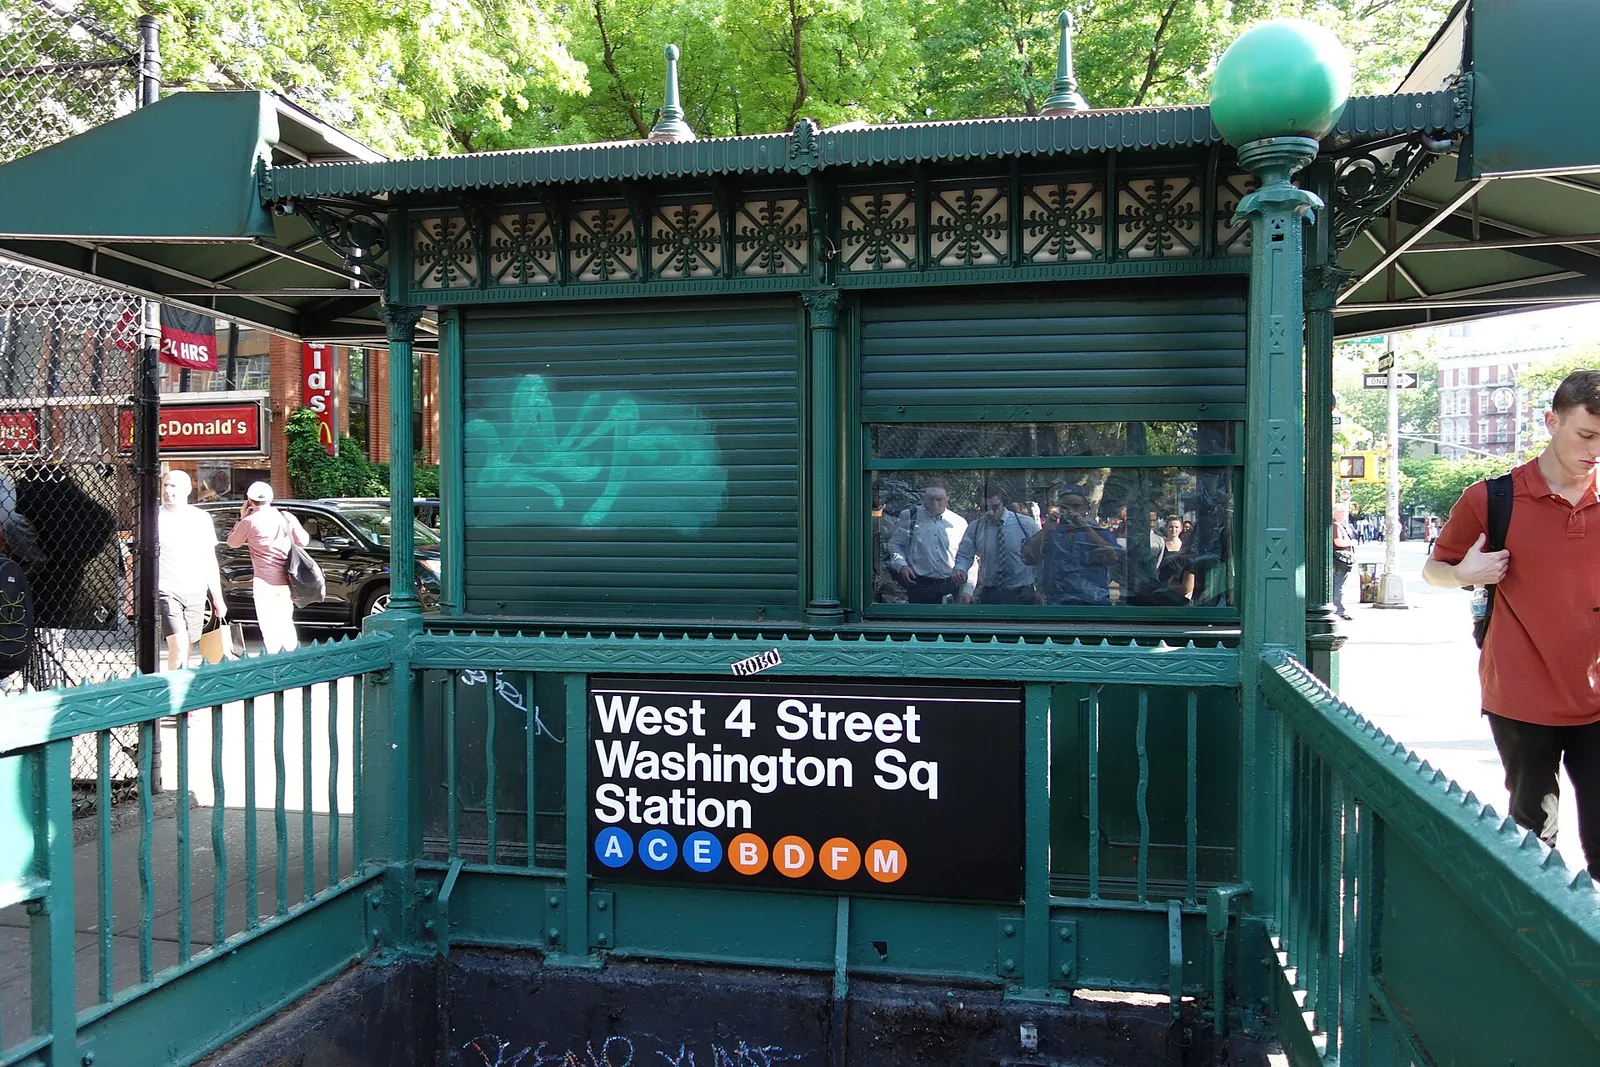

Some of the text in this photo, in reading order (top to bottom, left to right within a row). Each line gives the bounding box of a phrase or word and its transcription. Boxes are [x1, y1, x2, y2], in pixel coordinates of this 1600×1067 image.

[161, 338, 209, 362] 24 HRS
[1370, 378, 1387, 386] ONE
[159, 419, 247, 436] cDonald's
[733, 650, 779, 676] BOBO
[594, 694, 706, 737] West
[724, 698, 756, 738] 4
[775, 698, 921, 744] Street
[594, 739, 938, 800] Washington Sq
[594, 783, 752, 829] Station
[605, 835, 899, 874] A C E B D F M
